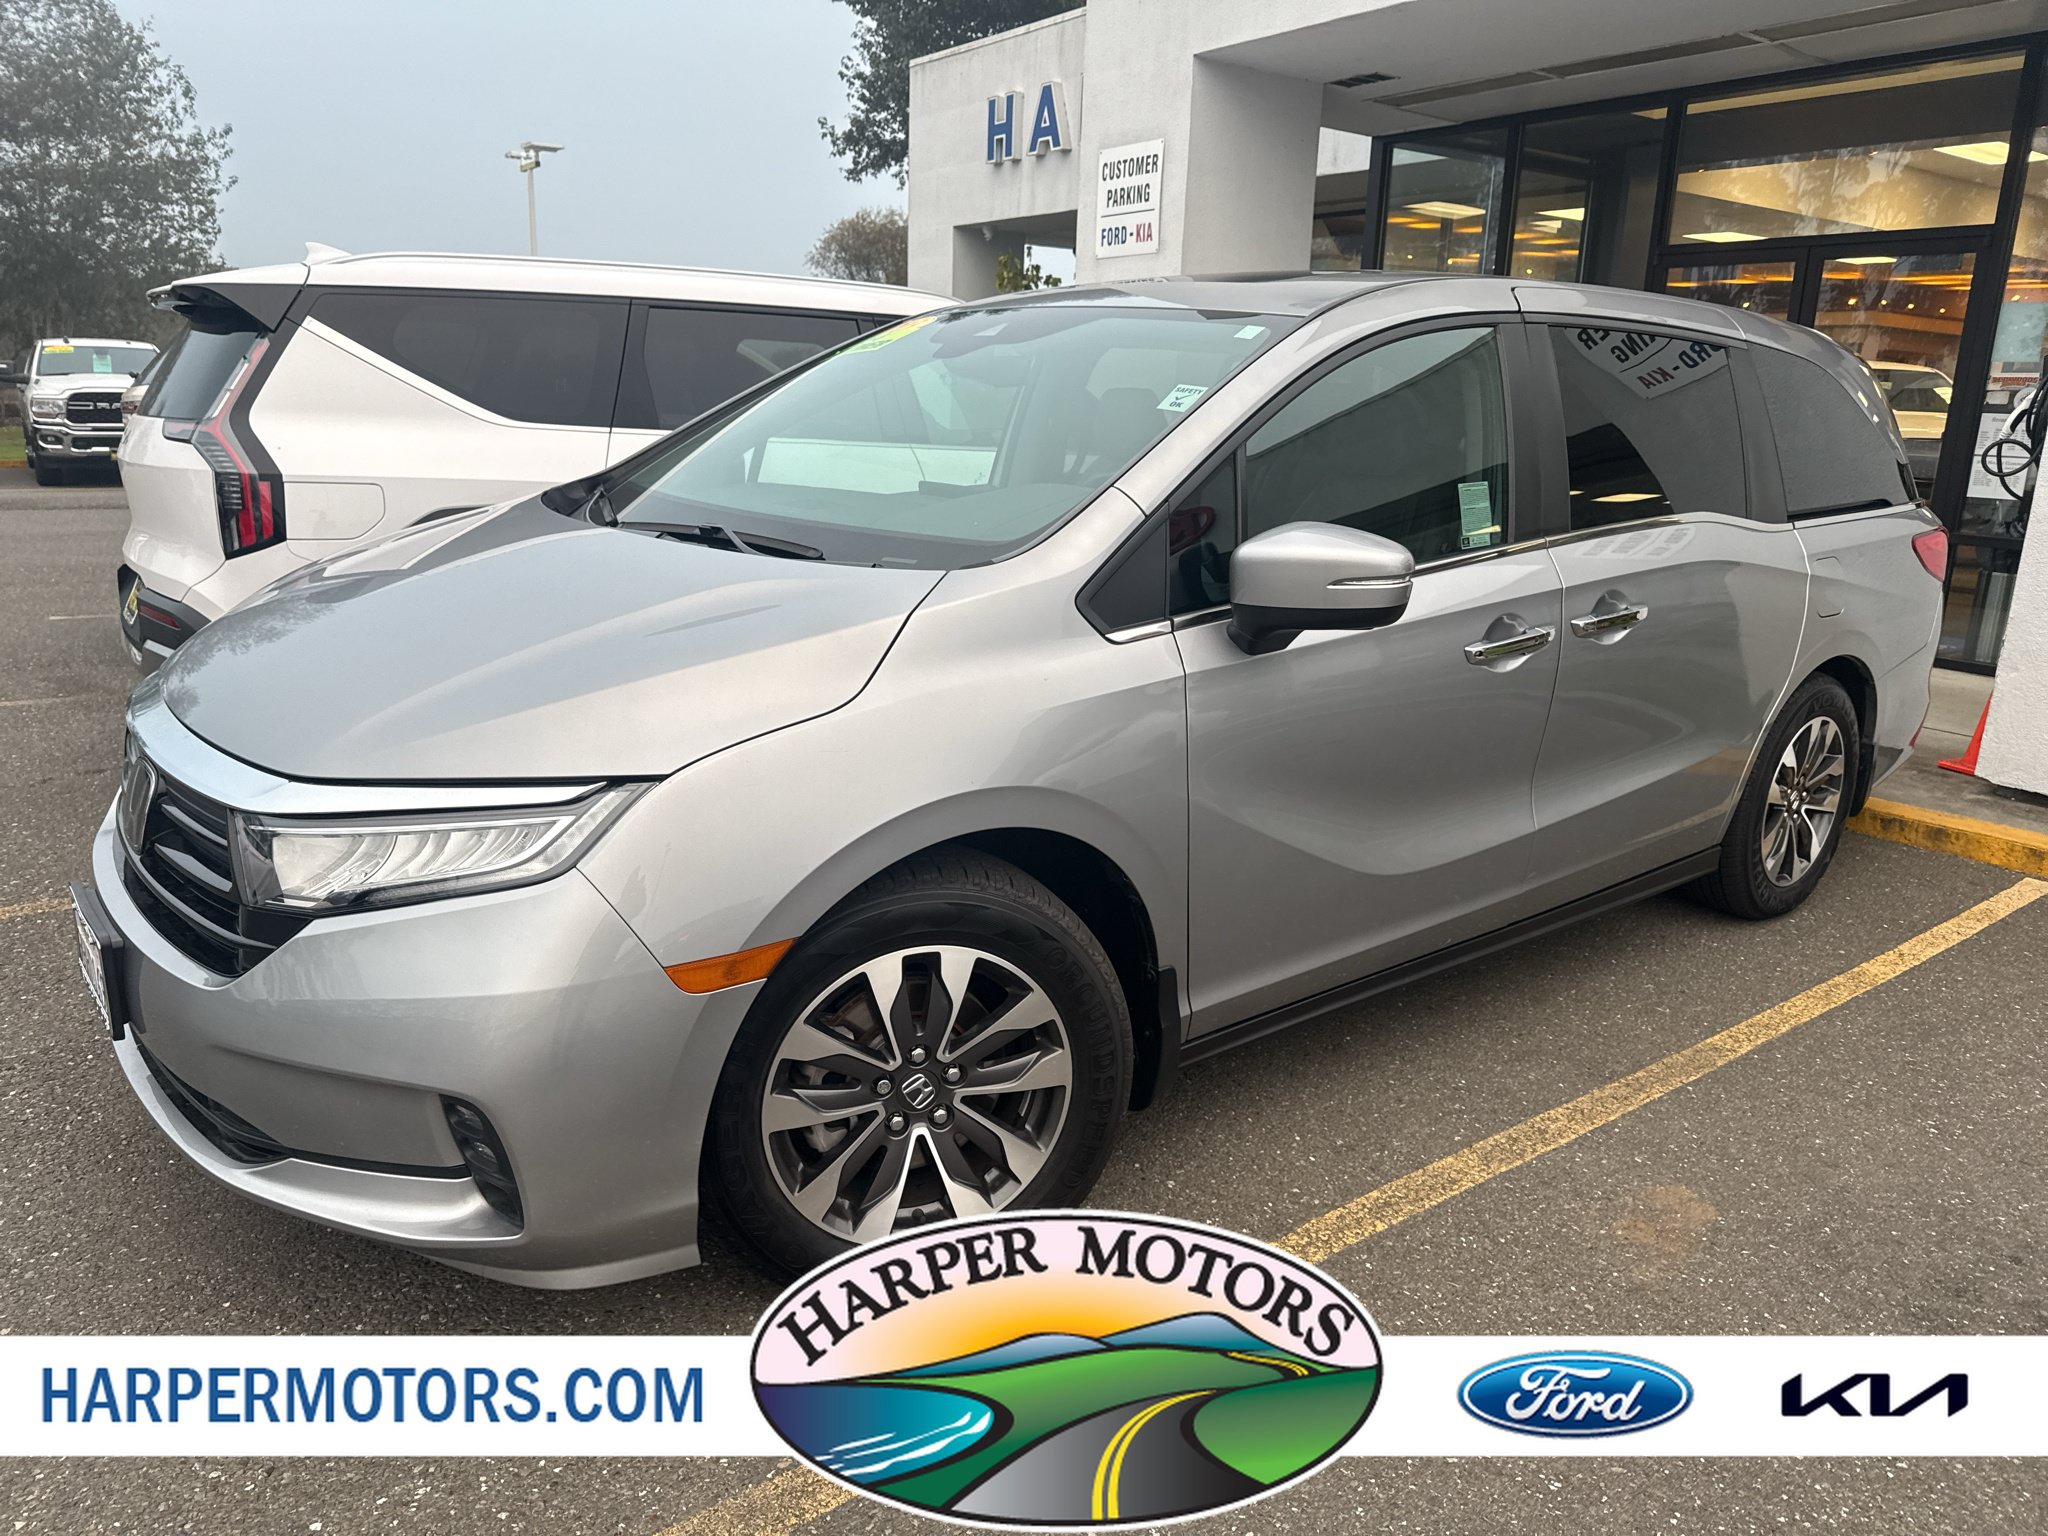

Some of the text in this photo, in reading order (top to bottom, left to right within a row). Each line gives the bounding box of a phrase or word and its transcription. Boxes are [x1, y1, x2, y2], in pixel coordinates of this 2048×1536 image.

[1101, 153, 1159, 182] CUSTOMER
[1106, 183, 1151, 208] PARKING
[1174, 386, 1204, 395] SAFETY
[96, 402, 121, 410] RA
